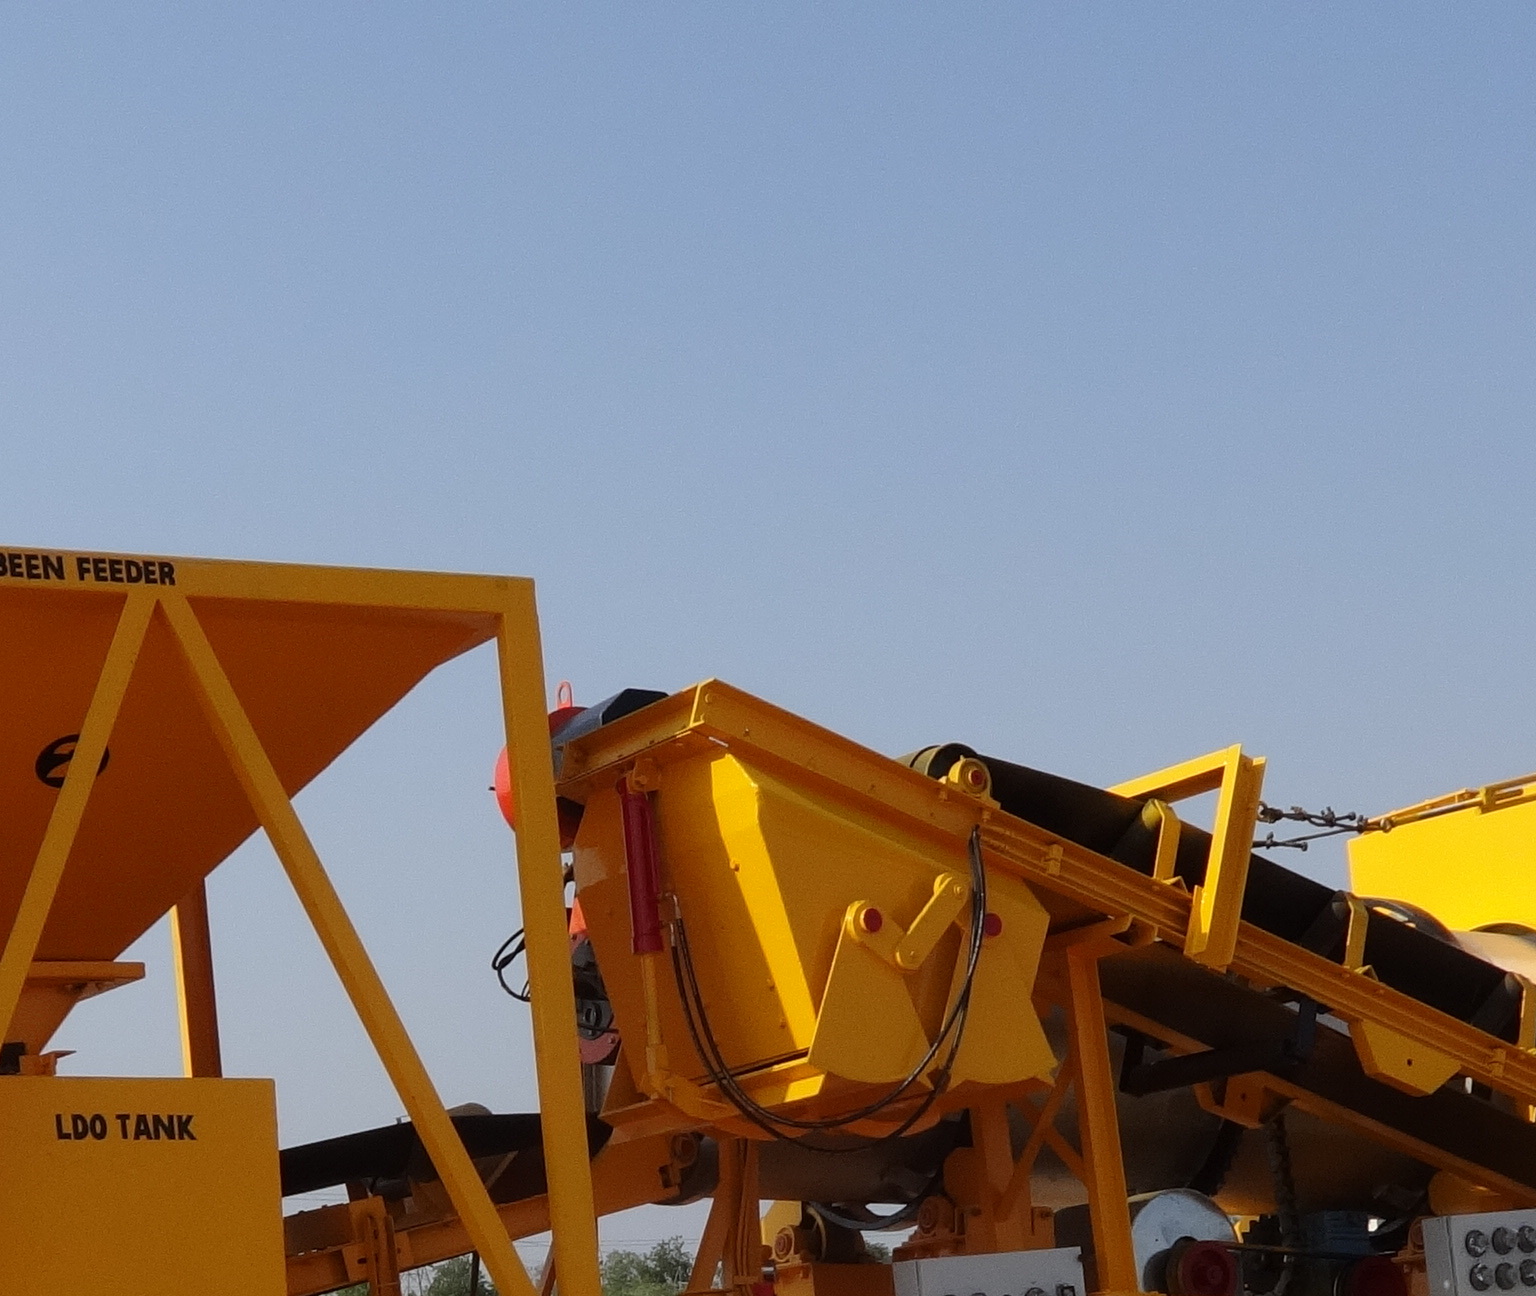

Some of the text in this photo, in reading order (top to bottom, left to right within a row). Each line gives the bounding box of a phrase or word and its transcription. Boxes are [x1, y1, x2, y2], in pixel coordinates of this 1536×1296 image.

[76, 556, 176, 586] FEEDER
[55, 1113, 198, 1141] LDO TANK
